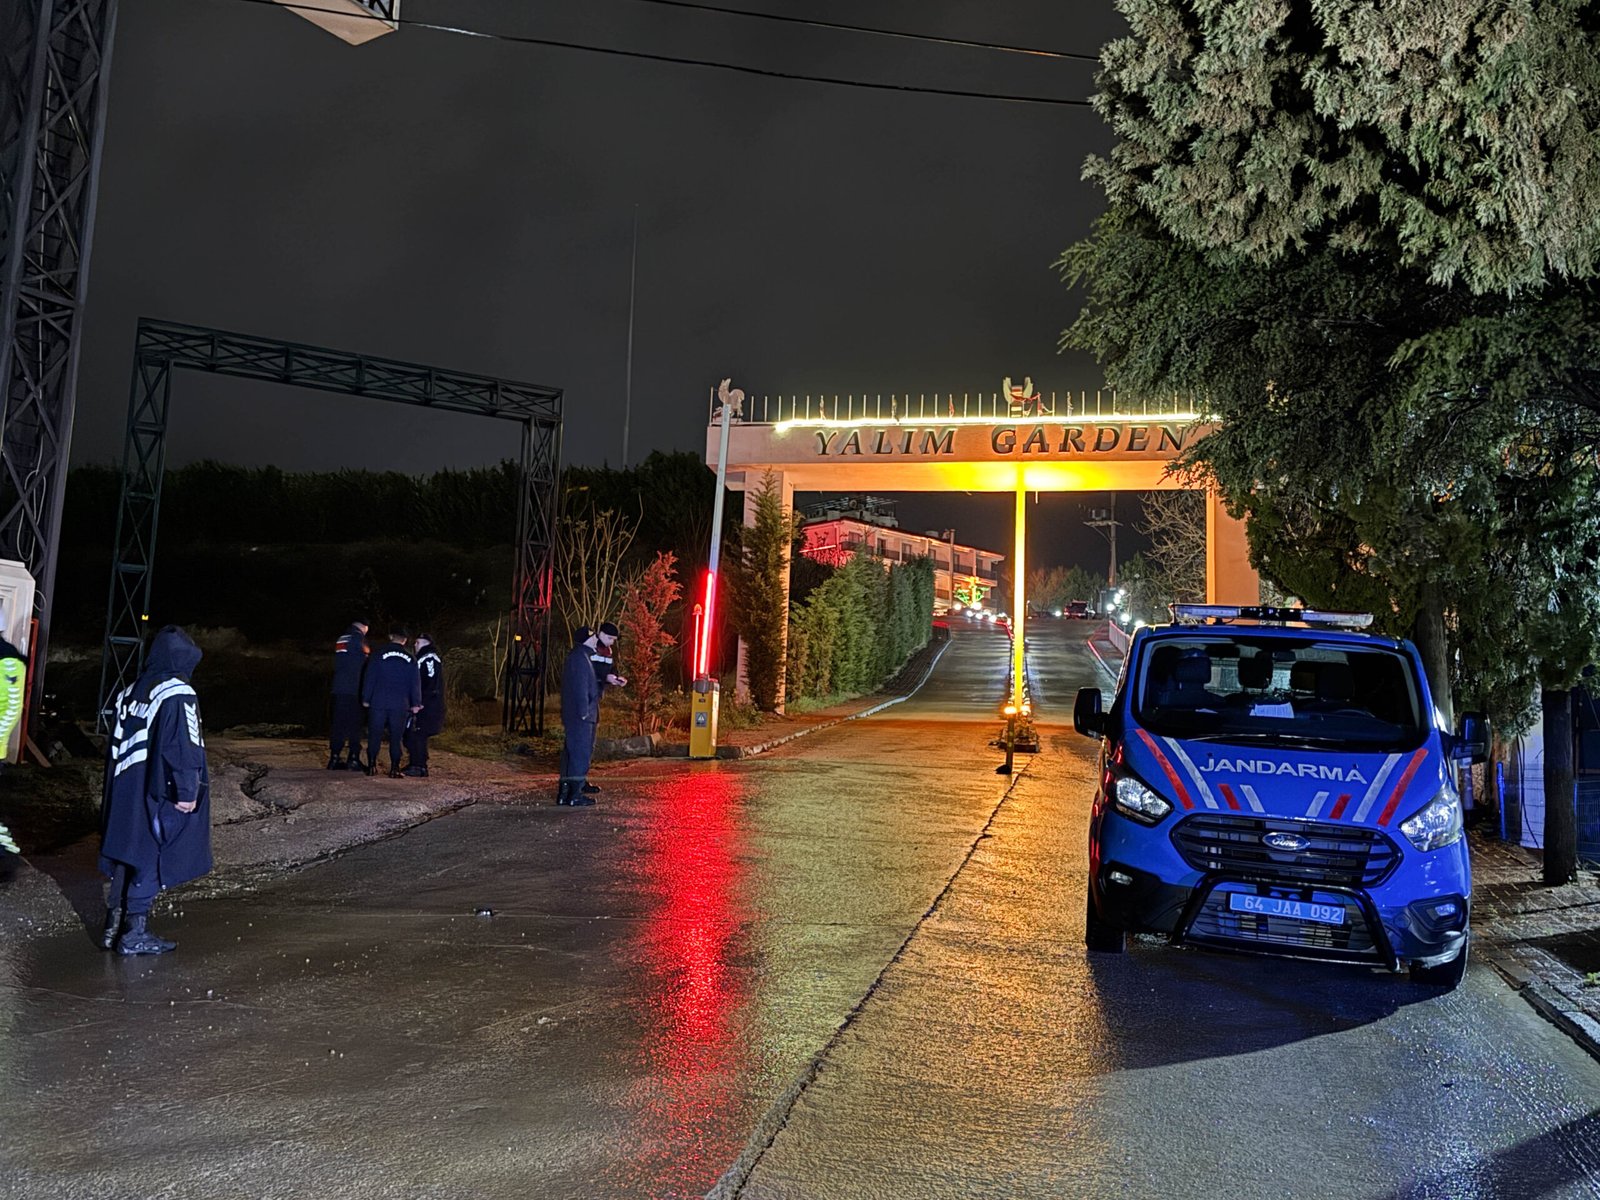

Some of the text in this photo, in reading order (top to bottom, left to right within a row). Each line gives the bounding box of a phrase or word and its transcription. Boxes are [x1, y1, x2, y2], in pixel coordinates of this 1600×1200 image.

[814, 424, 1188, 456] YALIM GARDEN
[1200, 758, 1368, 785] JANDARMA
[1243, 896, 1341, 921] 64 JAA 092
